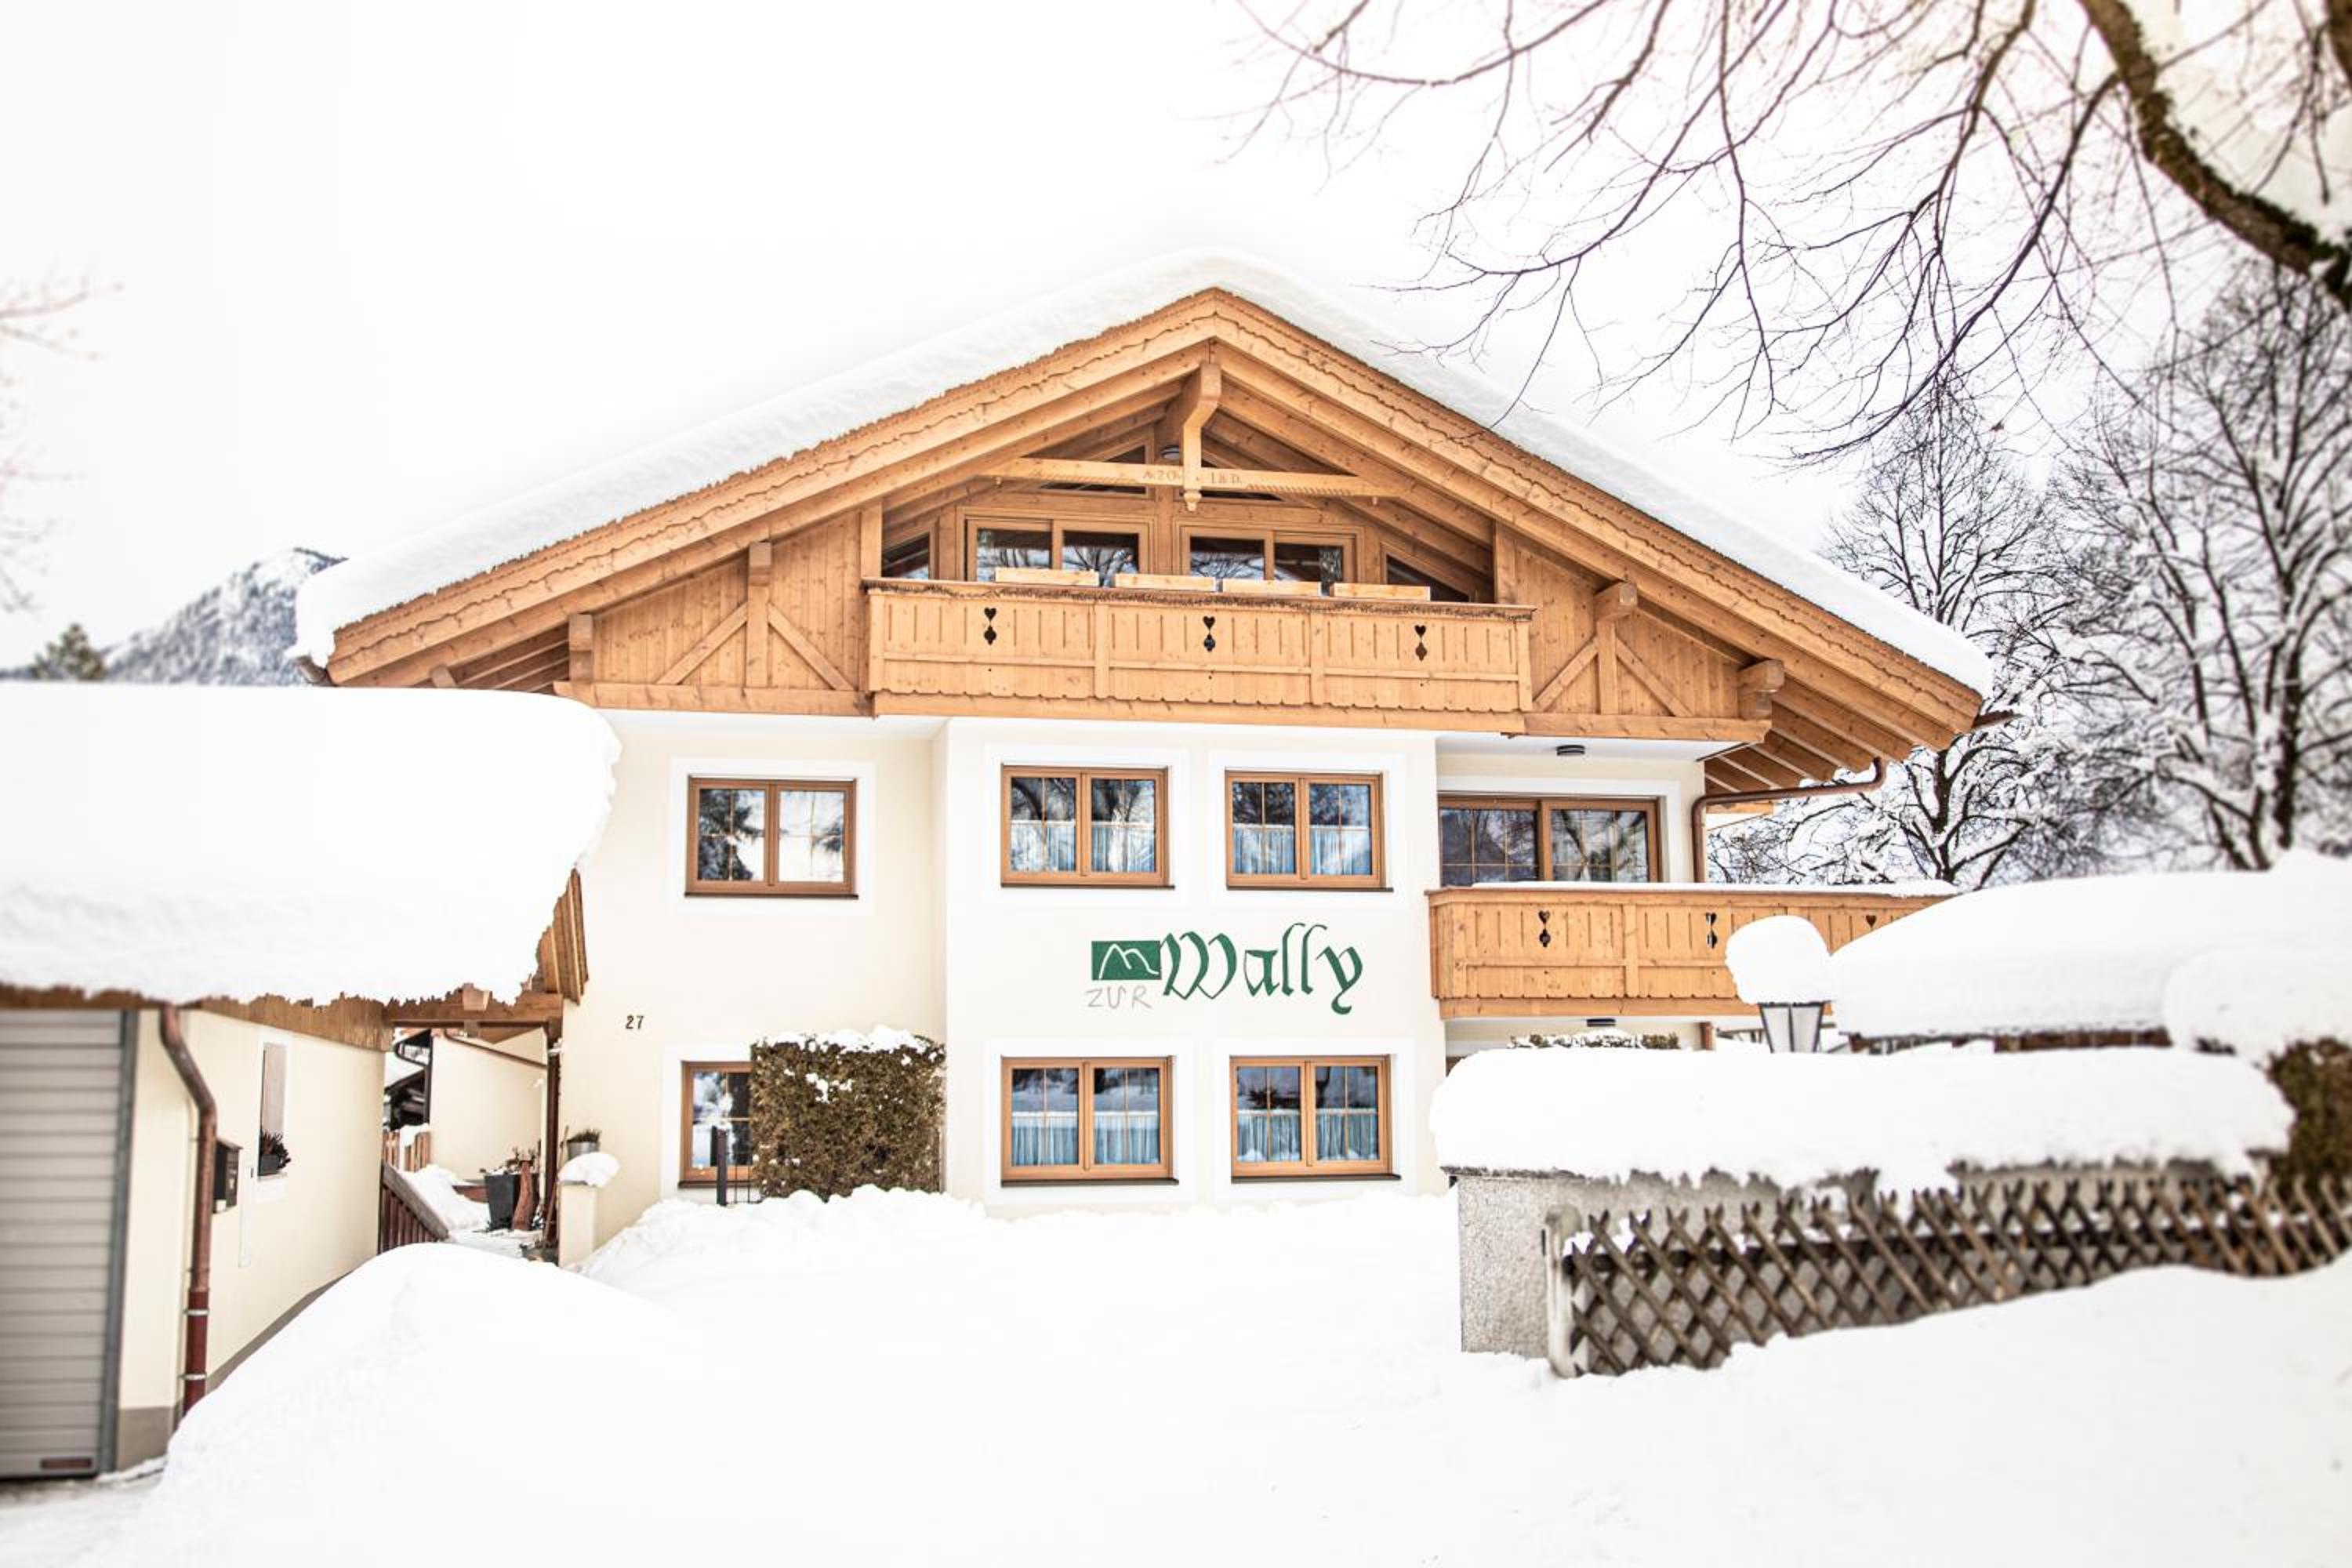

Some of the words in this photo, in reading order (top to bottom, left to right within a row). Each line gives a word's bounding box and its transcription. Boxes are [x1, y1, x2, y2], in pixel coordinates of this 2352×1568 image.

[1085, 985, 1152, 1009] ZUR
[1160, 923, 1363, 1015] Wally
[626, 1014, 644, 1029] 27
